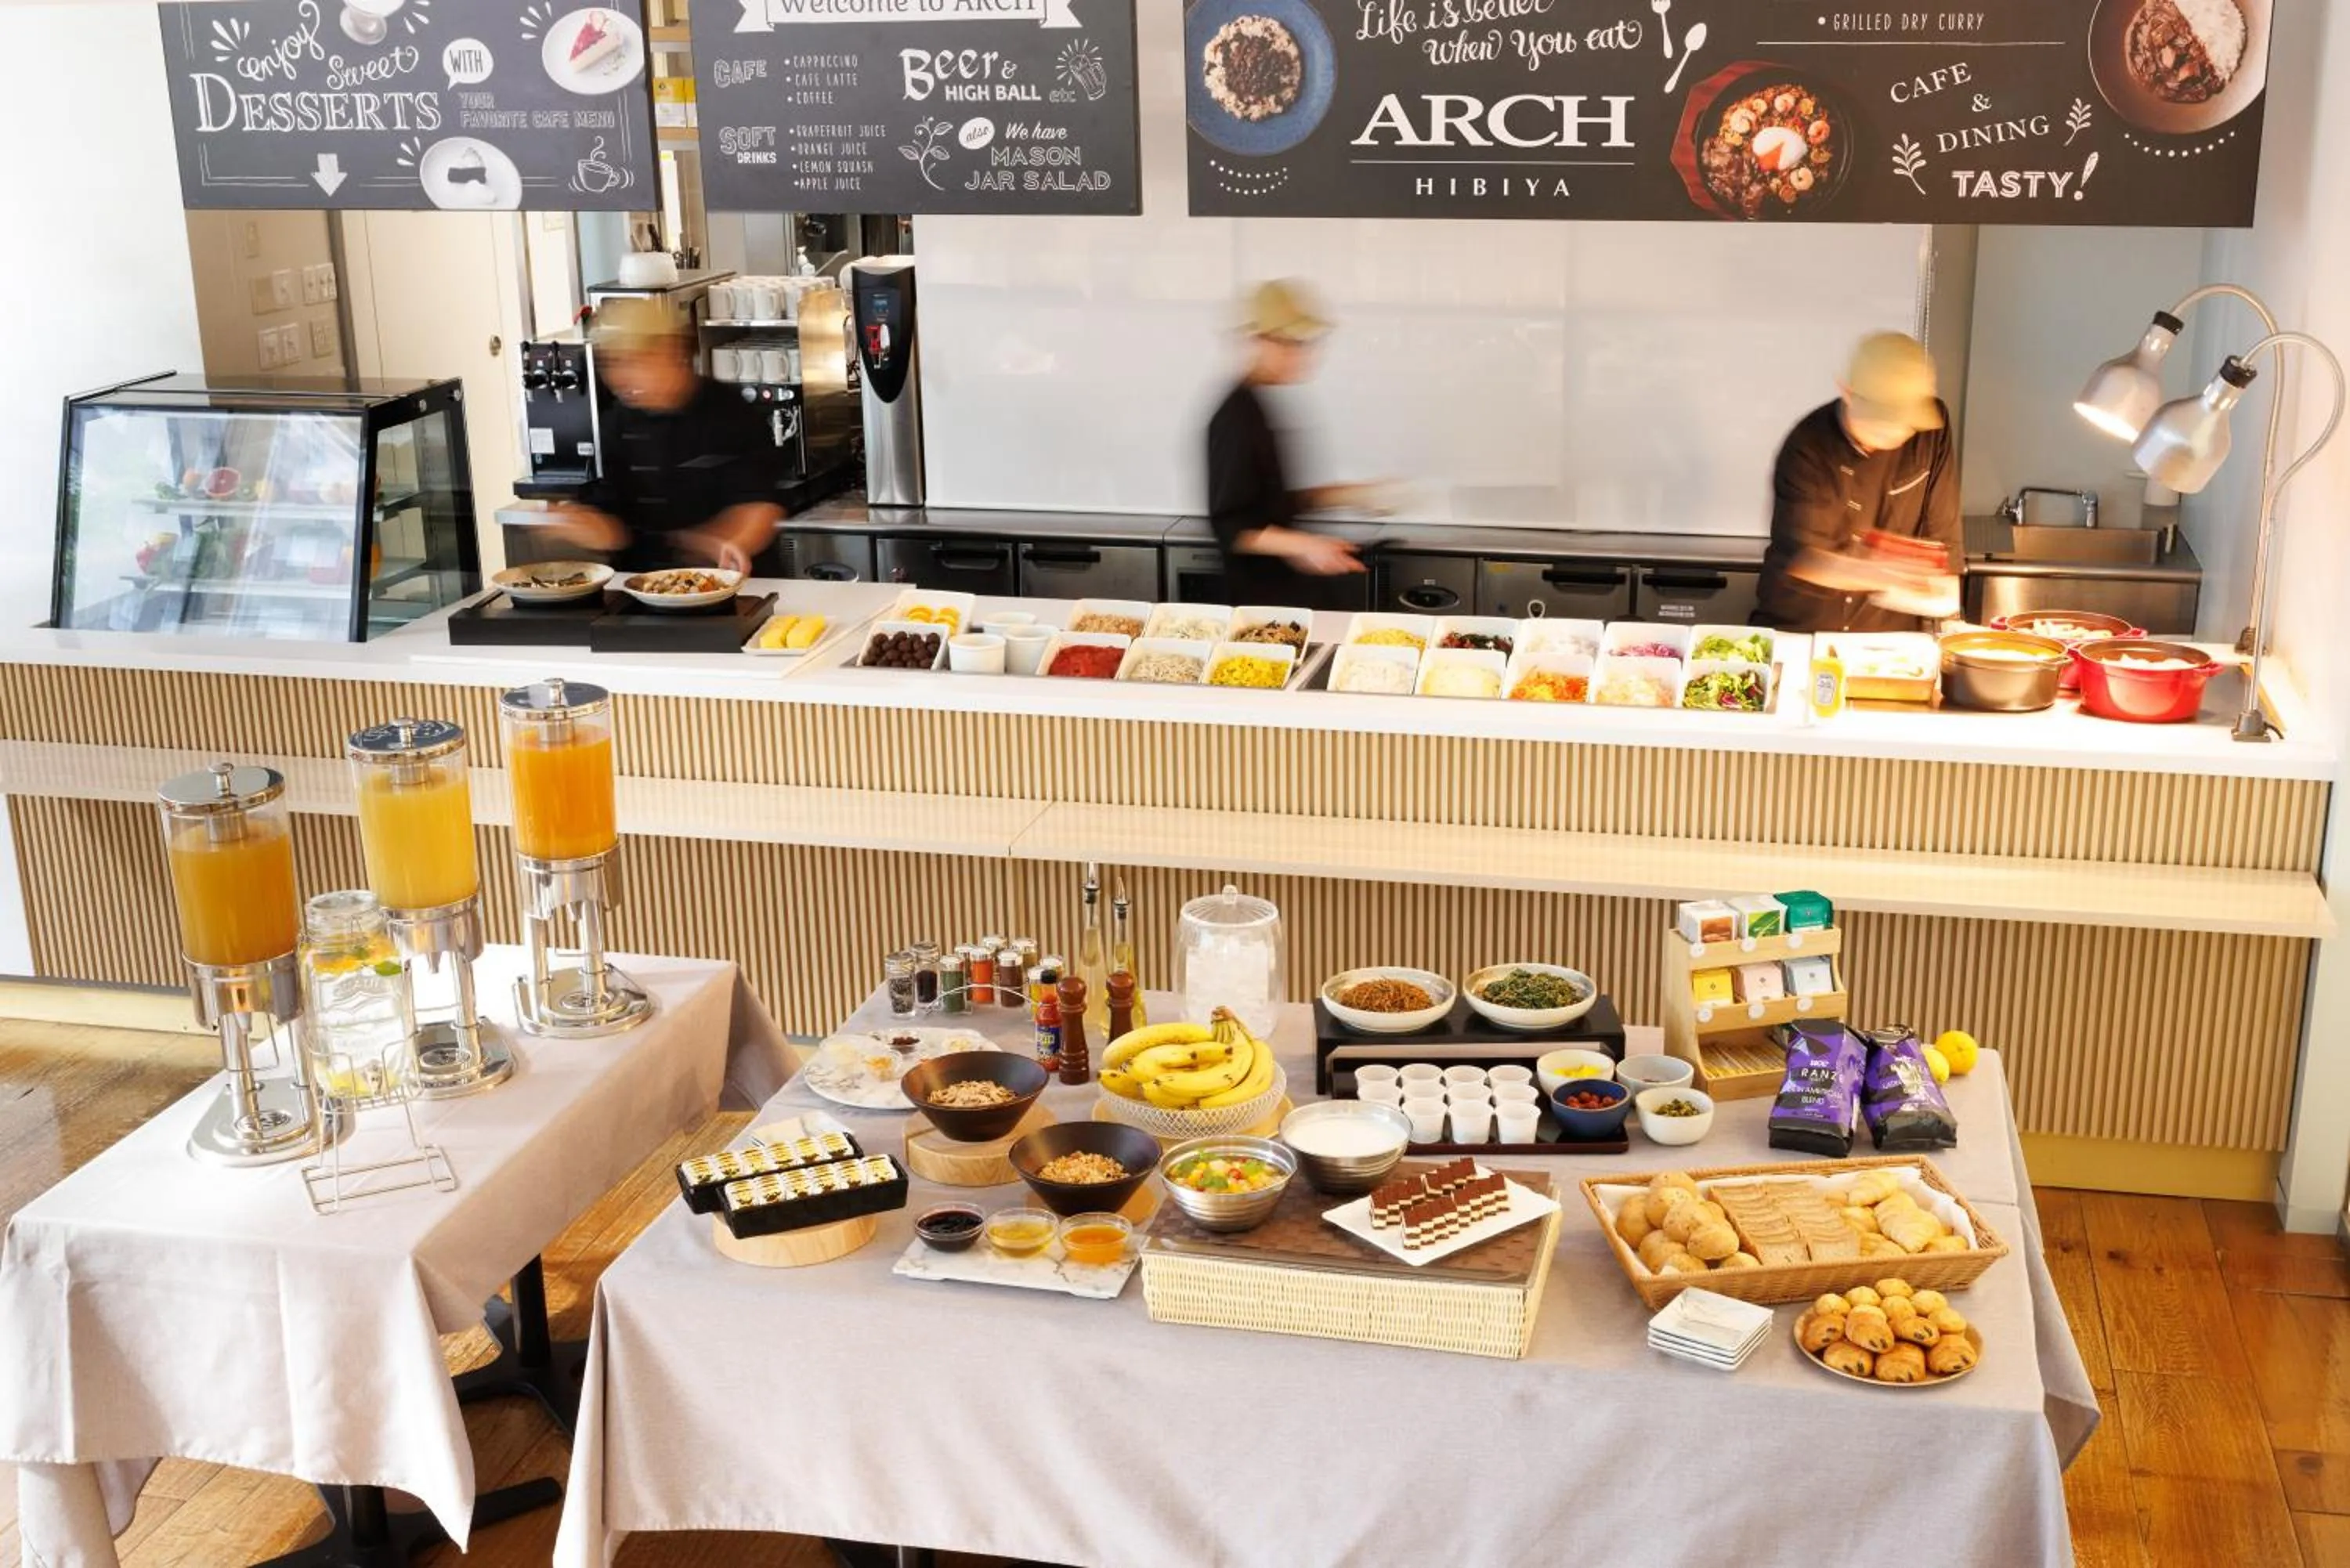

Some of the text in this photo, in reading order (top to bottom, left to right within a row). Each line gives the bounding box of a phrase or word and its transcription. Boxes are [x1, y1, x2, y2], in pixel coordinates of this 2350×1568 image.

[1356, 0, 1416, 45] Life
[1423, 0, 1460, 29] is
[1833, 13, 1985, 31] GRILLED DRY CURRY
[237, 0, 324, 81] enjoy
[1509, 29, 1576, 70] You
[1584, 20, 1643, 49] eat
[327, 45, 419, 89] Sweet
[450, 49, 483, 73] WITH
[794, 55, 859, 68] CAPPUCCINO
[714, 59, 768, 88] CAFE
[795, 73, 859, 87] CAFE LATTE
[899, 48, 1018, 101] Beer &
[1890, 62, 1972, 103] CAFE
[189, 73, 441, 132] DESSERTS
[796, 91, 834, 104] COFFEE
[945, 85, 1077, 103] HIGH BALL etc
[1971, 93, 1993, 112] &
[460, 110, 616, 128] FAVORITE CAFE MENU
[1350, 93, 1635, 147] ARCH
[719, 126, 776, 155] SOFT
[797, 125, 886, 137] GRAPEFRUIT JUICE
[965, 120, 1068, 143] also We have
[1936, 115, 2050, 153] DINING
[737, 151, 777, 164] DRINKS
[797, 142, 867, 155] ORANGE JUICE
[991, 146, 1082, 167] MASON
[800, 161, 874, 173] LEMON SQUASH
[1951, 151, 2099, 201] TASTY!
[800, 177, 861, 190] APPLE JUICE
[964, 171, 1112, 191] JAR SALAD
[1415, 179, 1570, 197] HIBIYA
